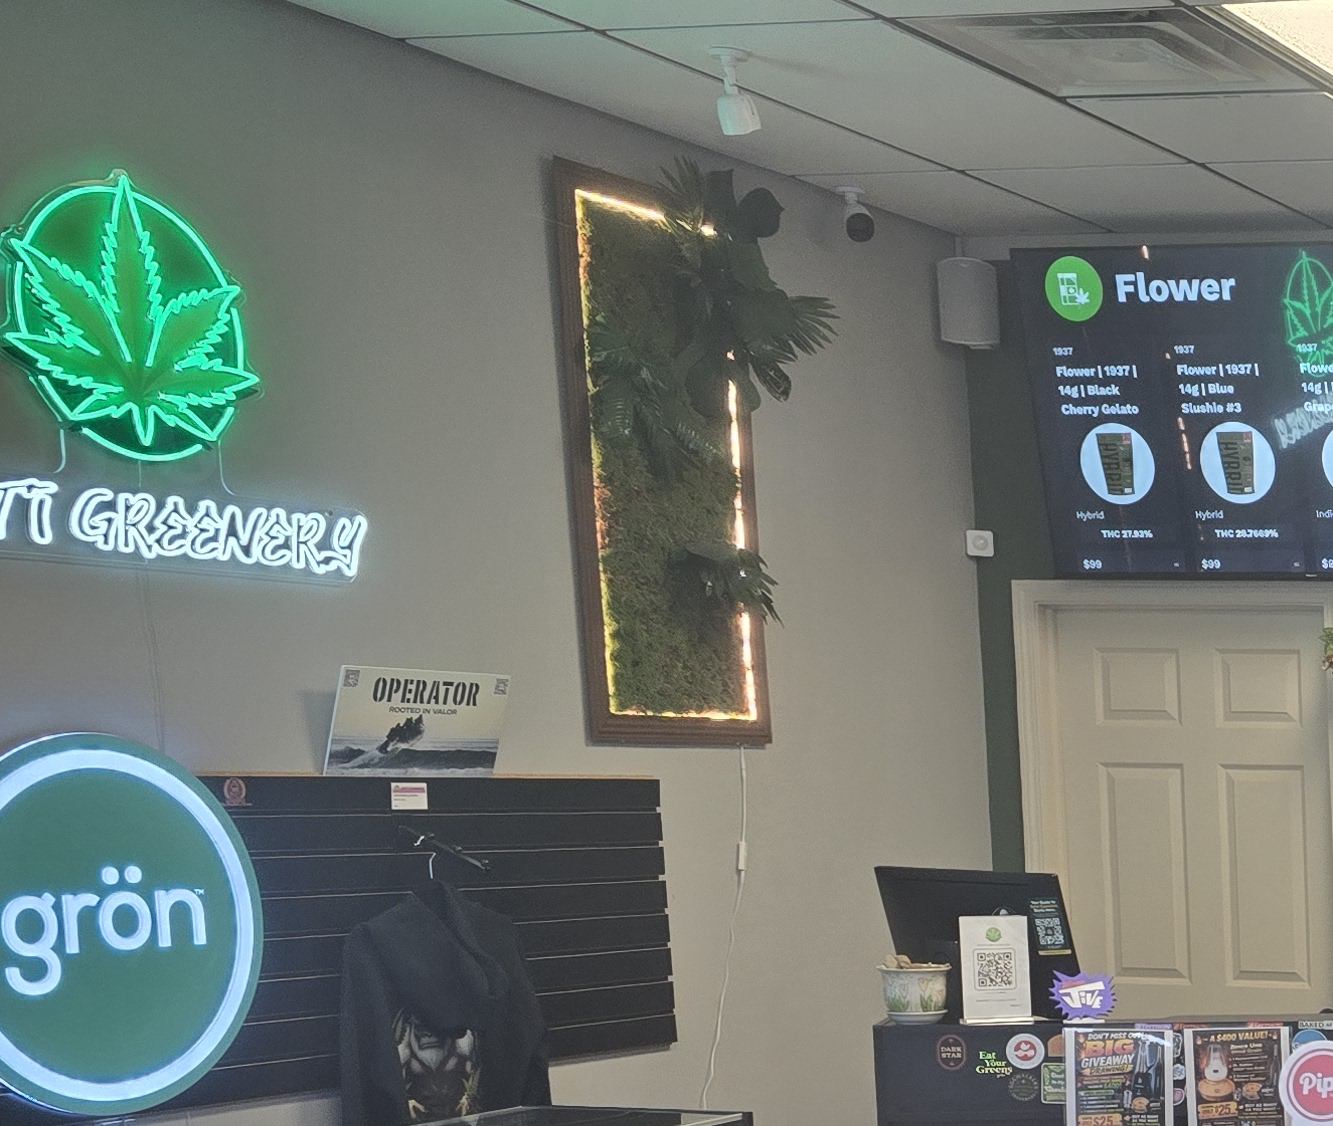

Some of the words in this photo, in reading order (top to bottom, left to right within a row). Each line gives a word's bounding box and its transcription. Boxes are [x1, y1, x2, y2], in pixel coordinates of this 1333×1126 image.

[1115, 273, 1235, 302] Flower
[1053, 347, 1073, 355] 1937
[1174, 346, 1194, 354] 1937
[1056, 366, 1095, 377] Flower
[1104, 365, 1130, 376] 1937
[1177, 365, 1216, 376] Flower
[1225, 364, 1252, 375] 1937
[1087, 385, 1120, 396] Black
[1208, 383, 1234, 394] Blue
[1061, 404, 1099, 417] Cherry
[1102, 404, 1139, 415] Gelato
[1181, 402, 1223, 413] Slushie
[70, 487, 368, 576] GREENERY
[373, 677, 480, 706] OPERATOR
[1239, 1031, 1268, 1041] VALUE!
[1086, 1040, 1134, 1056] BIG
[1081, 1055, 1135, 1068] GIVEAWAY
[976, 1066, 1012, 1075] Greens
[1214, 1104, 1231, 1115] $25
[1094, 1117, 1113, 1126] $25
